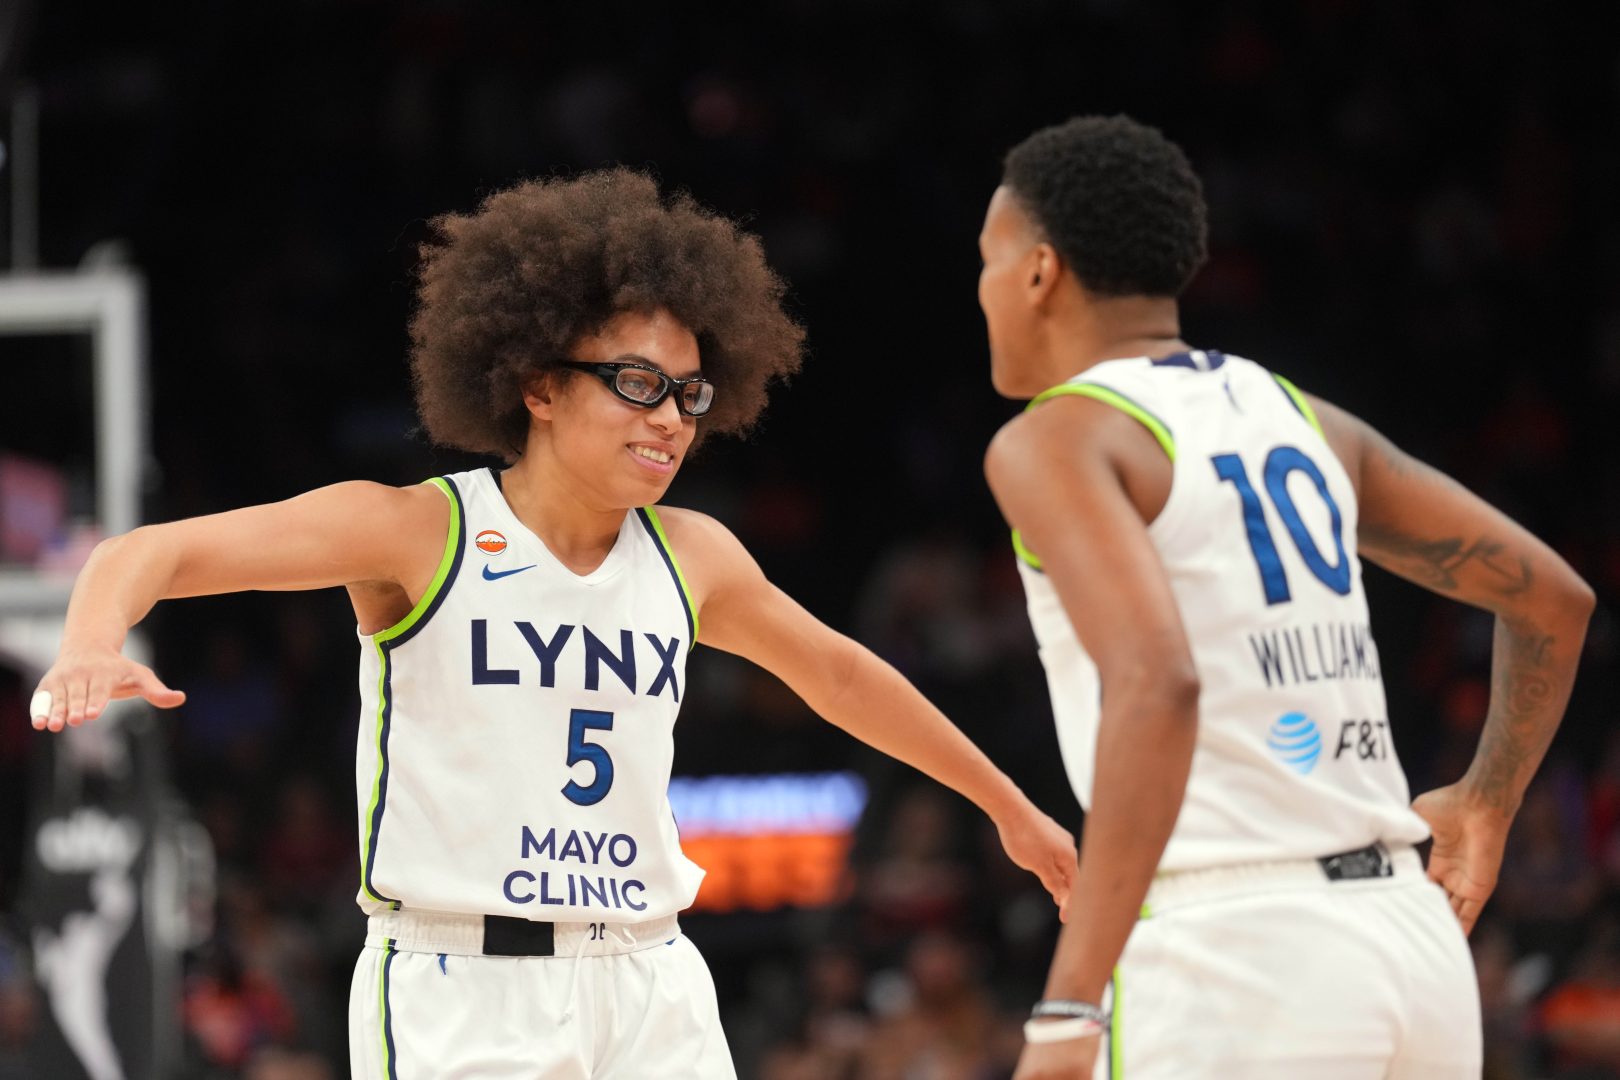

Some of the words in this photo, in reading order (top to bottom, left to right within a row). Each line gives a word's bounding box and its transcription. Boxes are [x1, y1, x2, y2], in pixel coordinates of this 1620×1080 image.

[1210, 444, 1352, 605] 10
[471, 619, 679, 703] LYNX
[561, 708, 614, 806] 5
[521, 826, 637, 868] MAYO
[503, 870, 647, 911] CLINIC
